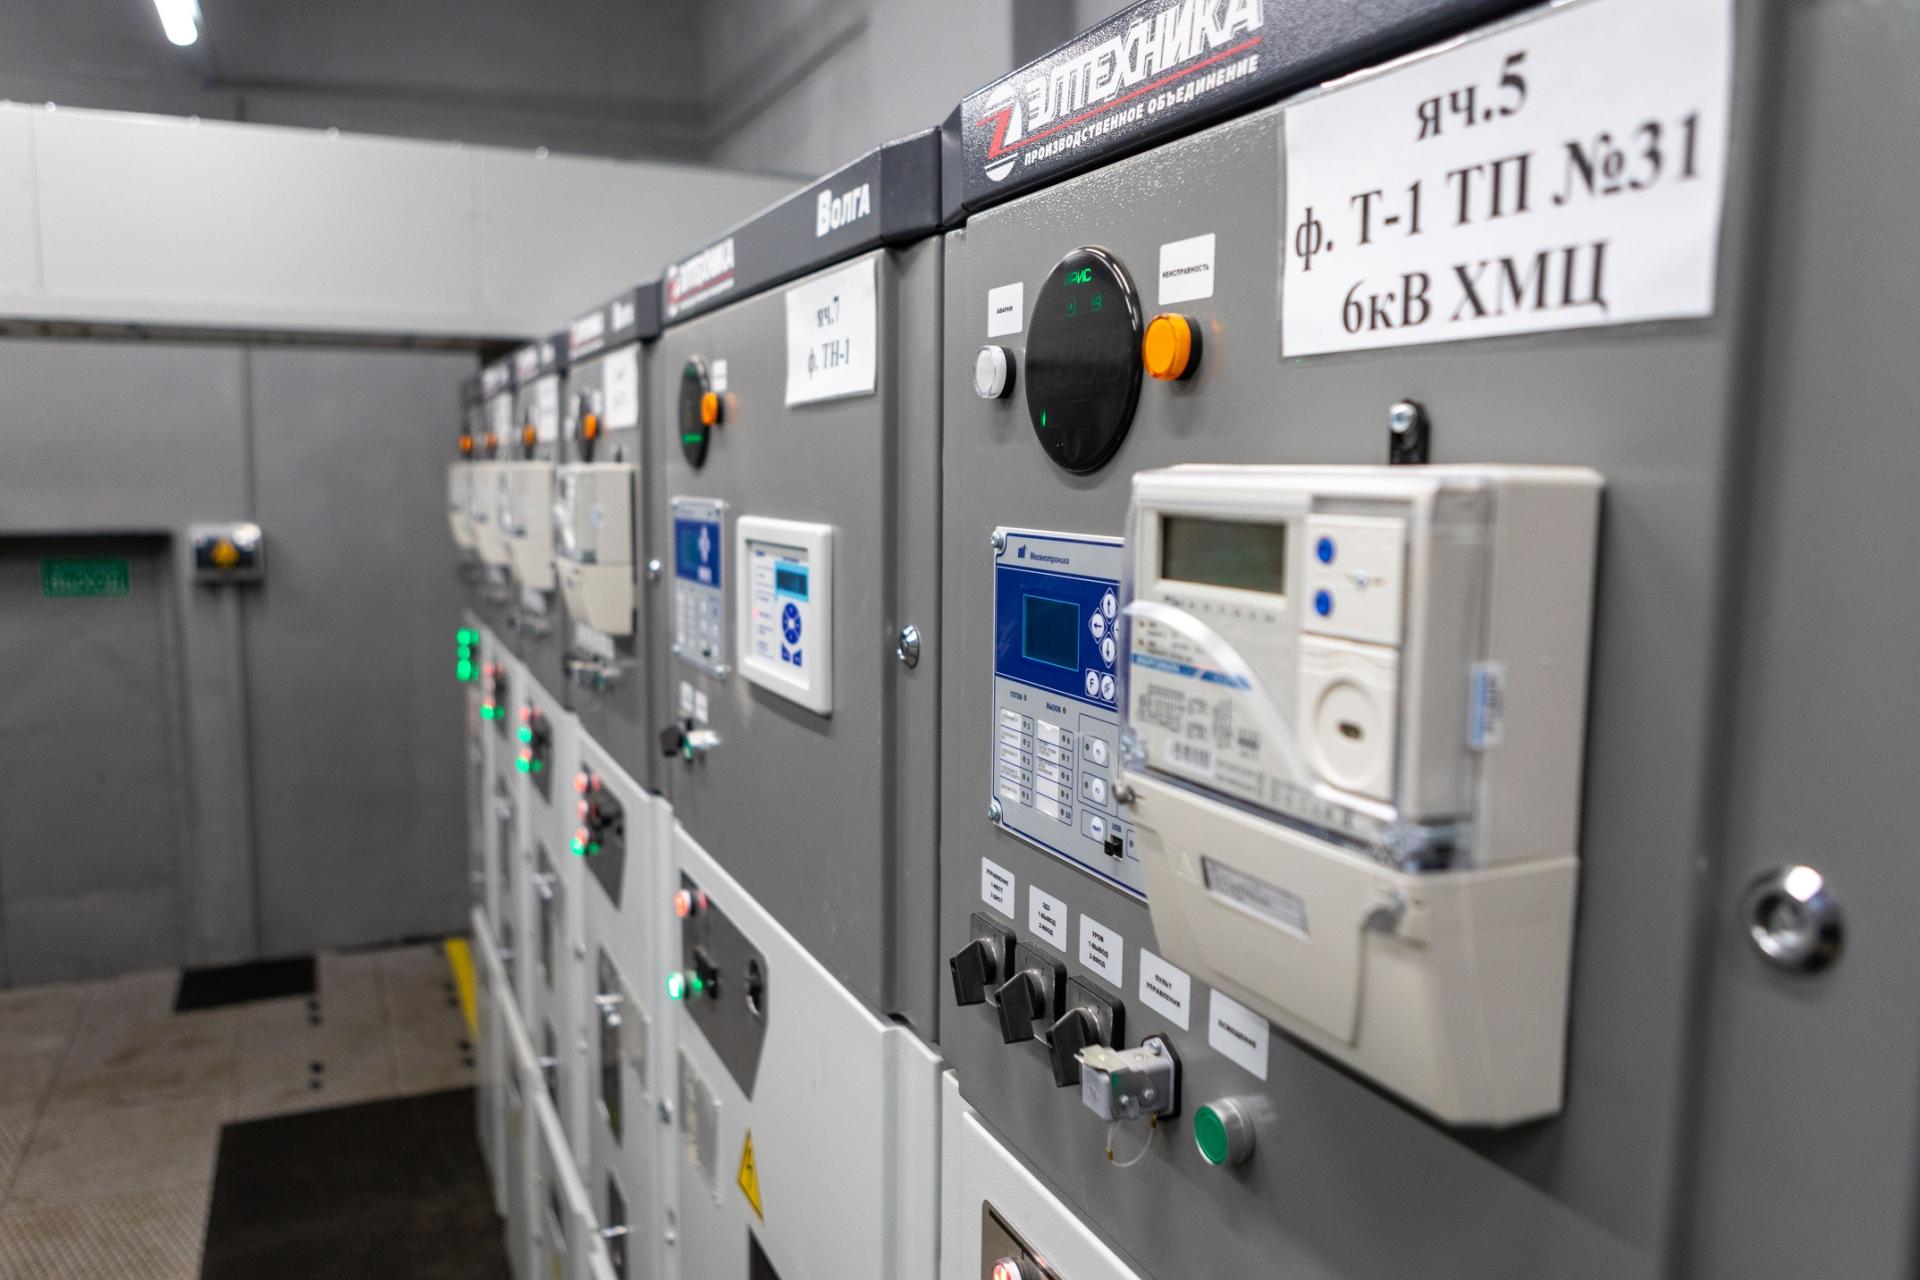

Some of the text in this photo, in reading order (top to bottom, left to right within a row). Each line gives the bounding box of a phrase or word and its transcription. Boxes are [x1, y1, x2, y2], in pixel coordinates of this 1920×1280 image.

[1025, 54, 1260, 166] ПРОИЗВОДСТВЕННОЕ ОБЪЕДИНЕНИЕ
[1416, 51, 1528, 141] яч.5
[1294, 111, 1703, 271] ф. Т-1 ТП №31
[817, 296, 840, 328] яч.7
[1162, 264, 1209, 279] НЕИСПРАВНОСТЬ
[1341, 238, 1613, 334] 6кВ ХМЦ
